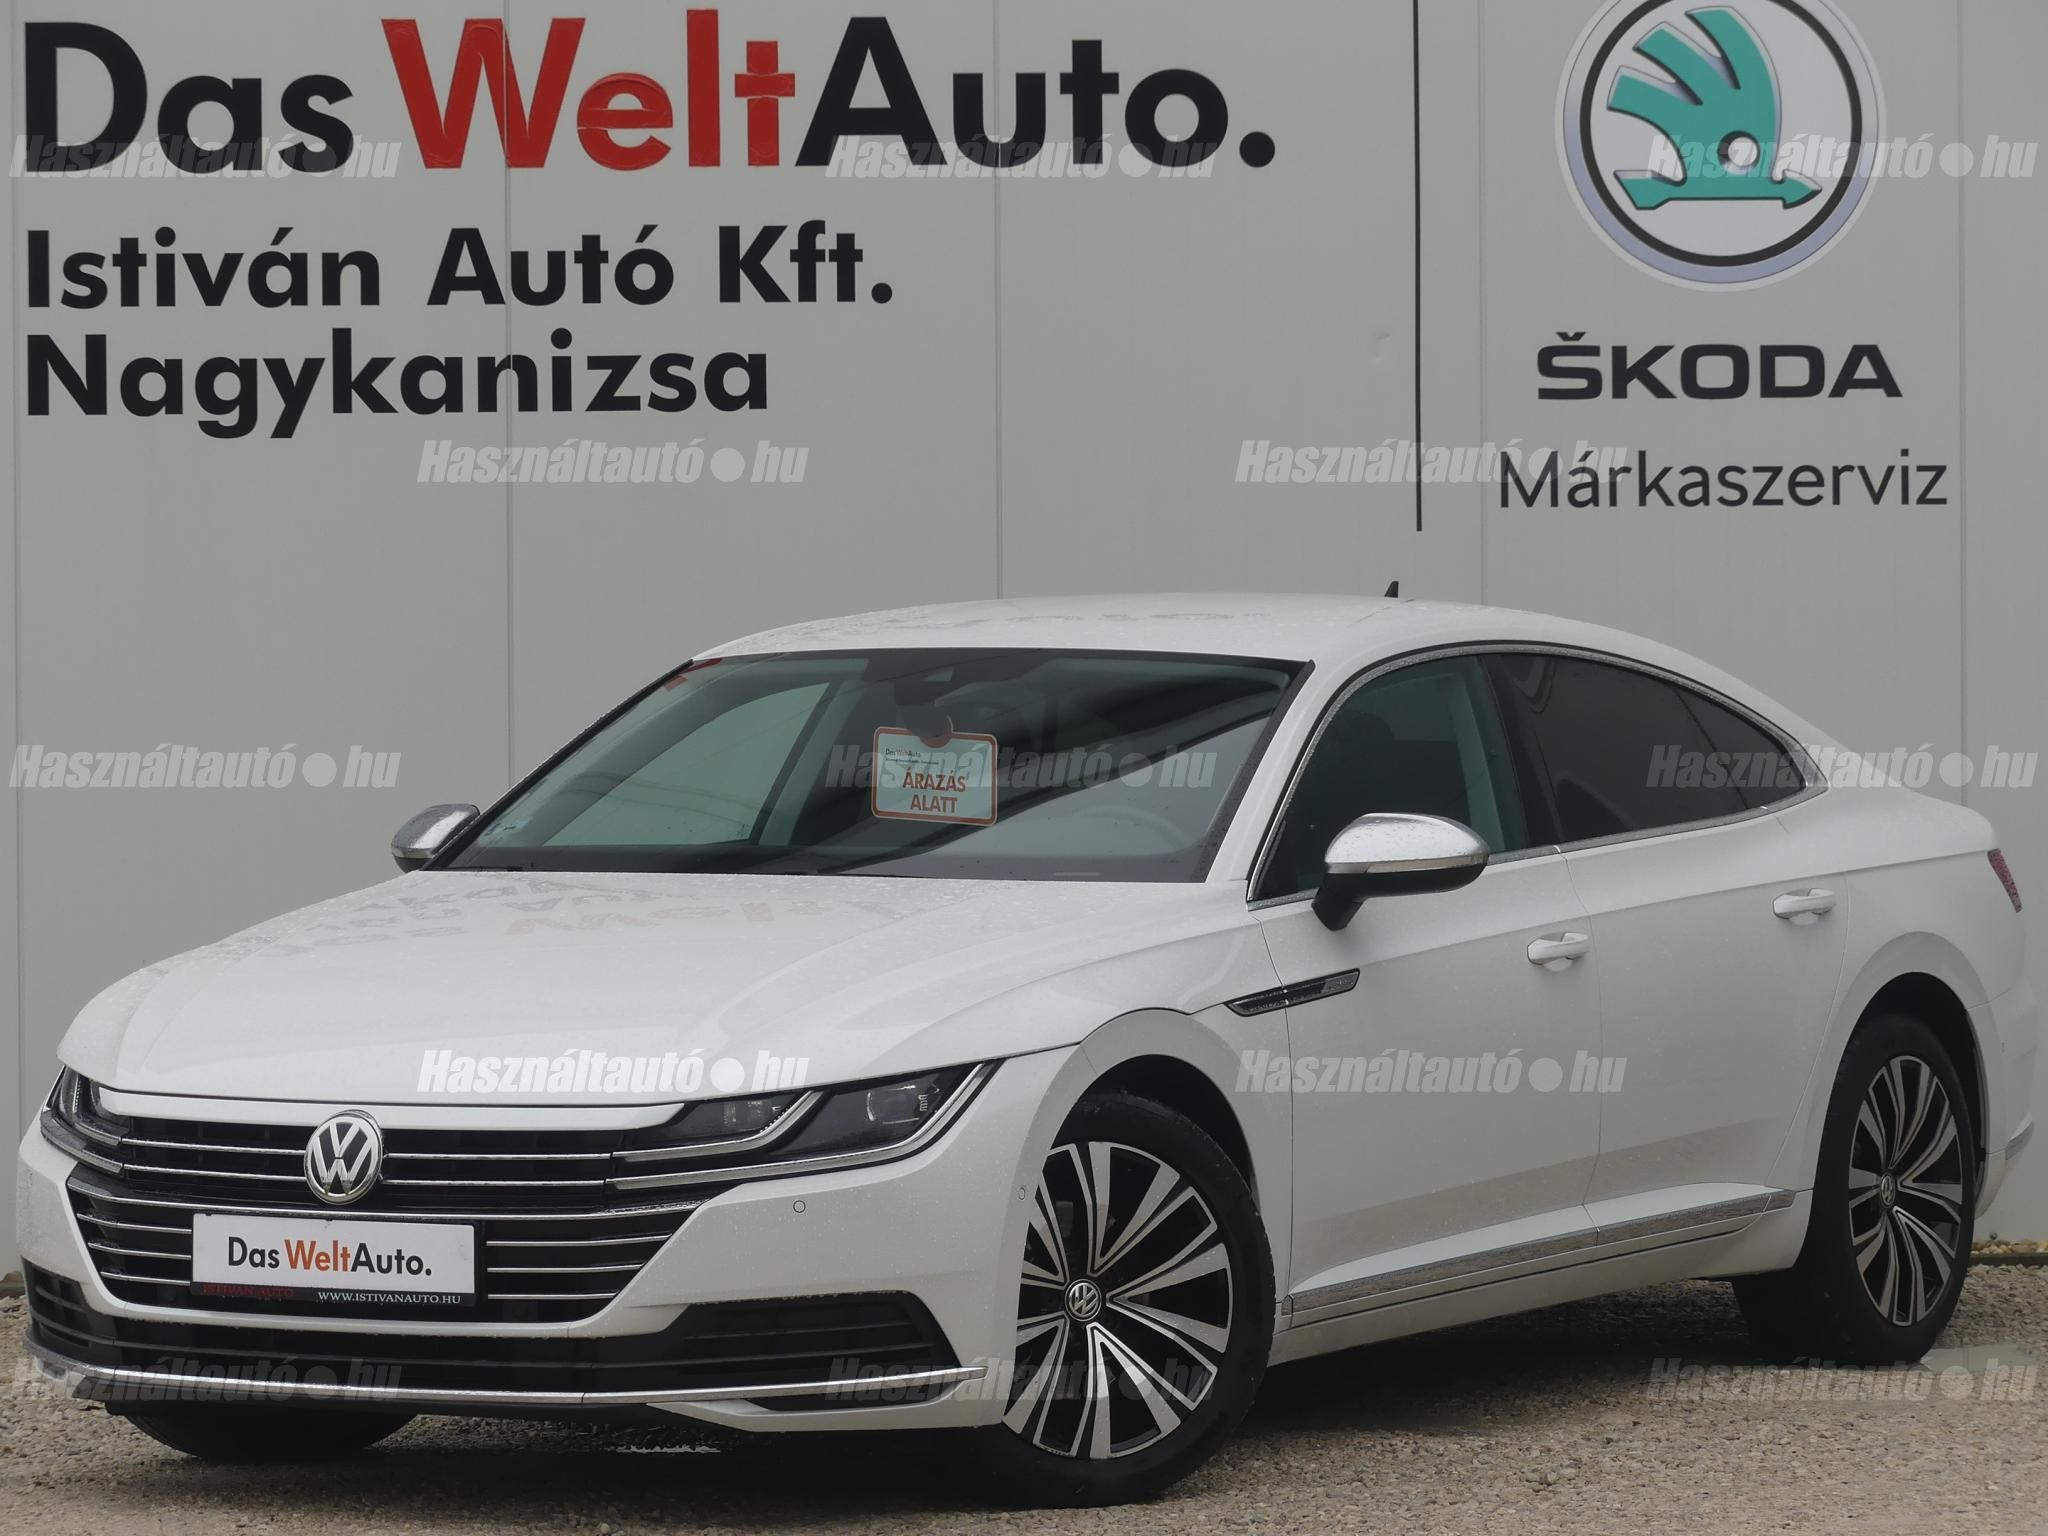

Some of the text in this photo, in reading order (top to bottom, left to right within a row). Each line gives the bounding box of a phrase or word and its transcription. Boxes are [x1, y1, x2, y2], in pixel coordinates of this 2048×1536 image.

[25, 9, 1275, 173] Das WeltAuto.
[27, 219, 893, 309] Istiván Autó Kft.
[27, 327, 767, 438] Nagykanizsa
[1537, 331, 1903, 400] ŠKODA
[1499, 449, 1948, 508] Márkaszerviz
[902, 767, 966, 792] ÁRAZÁS
[910, 794, 958, 813] ALATT
[228, 1236, 432, 1276] Das WeltAuto.
[318, 1291, 461, 1304] WWW.ISTIVANAUTO.HU
